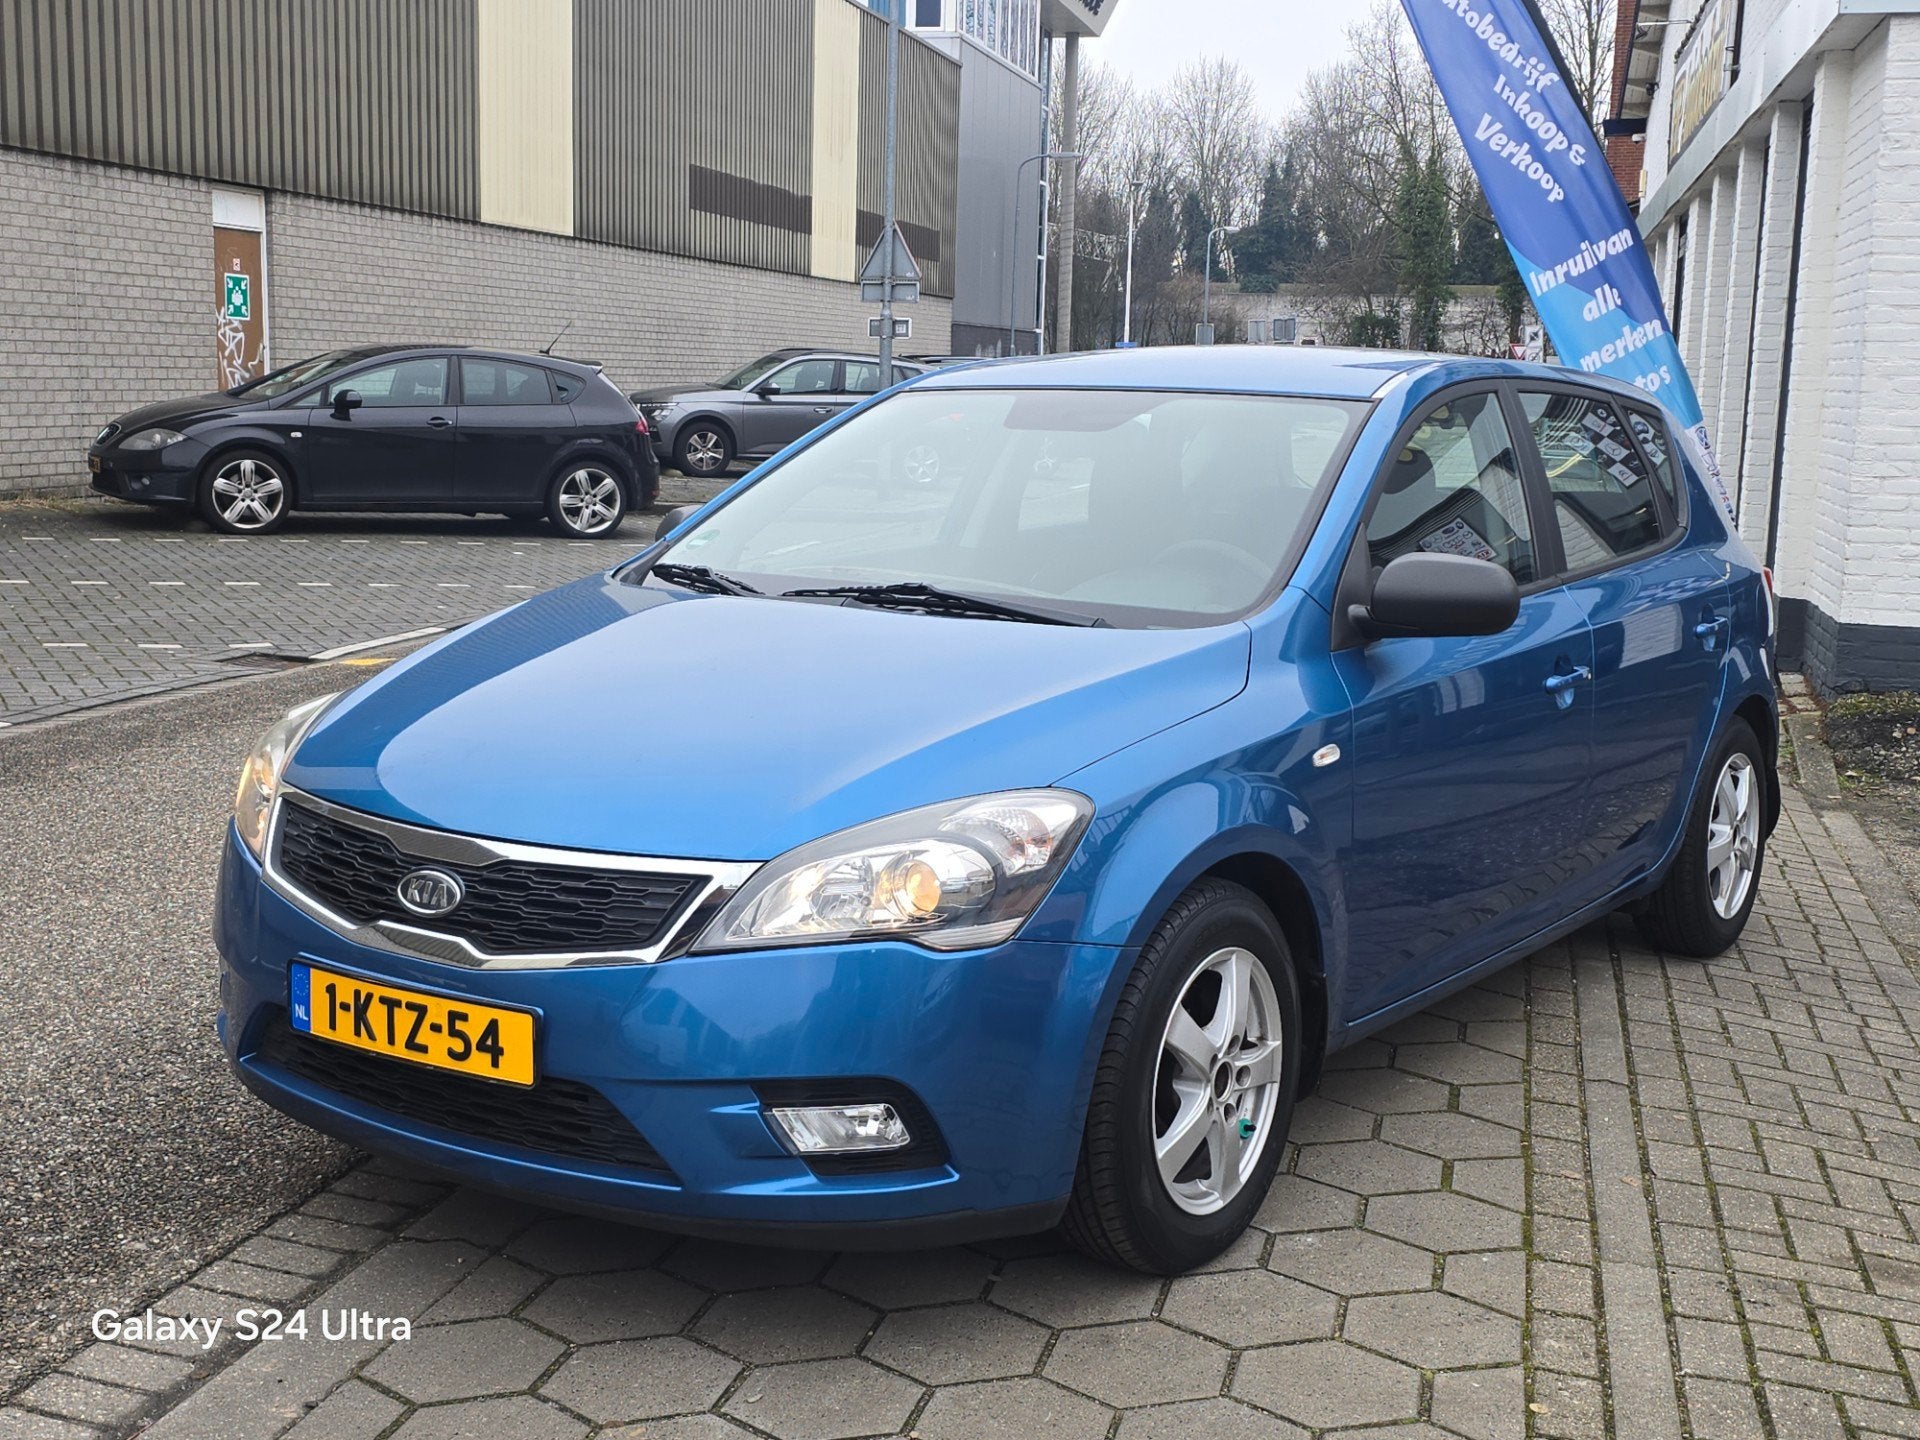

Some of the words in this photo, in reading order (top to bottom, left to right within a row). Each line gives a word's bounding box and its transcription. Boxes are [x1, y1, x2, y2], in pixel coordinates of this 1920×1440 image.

[1474, 113, 1565, 202] Verkoop
[1583, 283, 1622, 322] alle
[1580, 319, 1664, 373] merken
[406, 878, 448, 907] KIA
[295, 1005, 309, 1021] NL
[325, 982, 504, 1069] 1-KTZ-54
